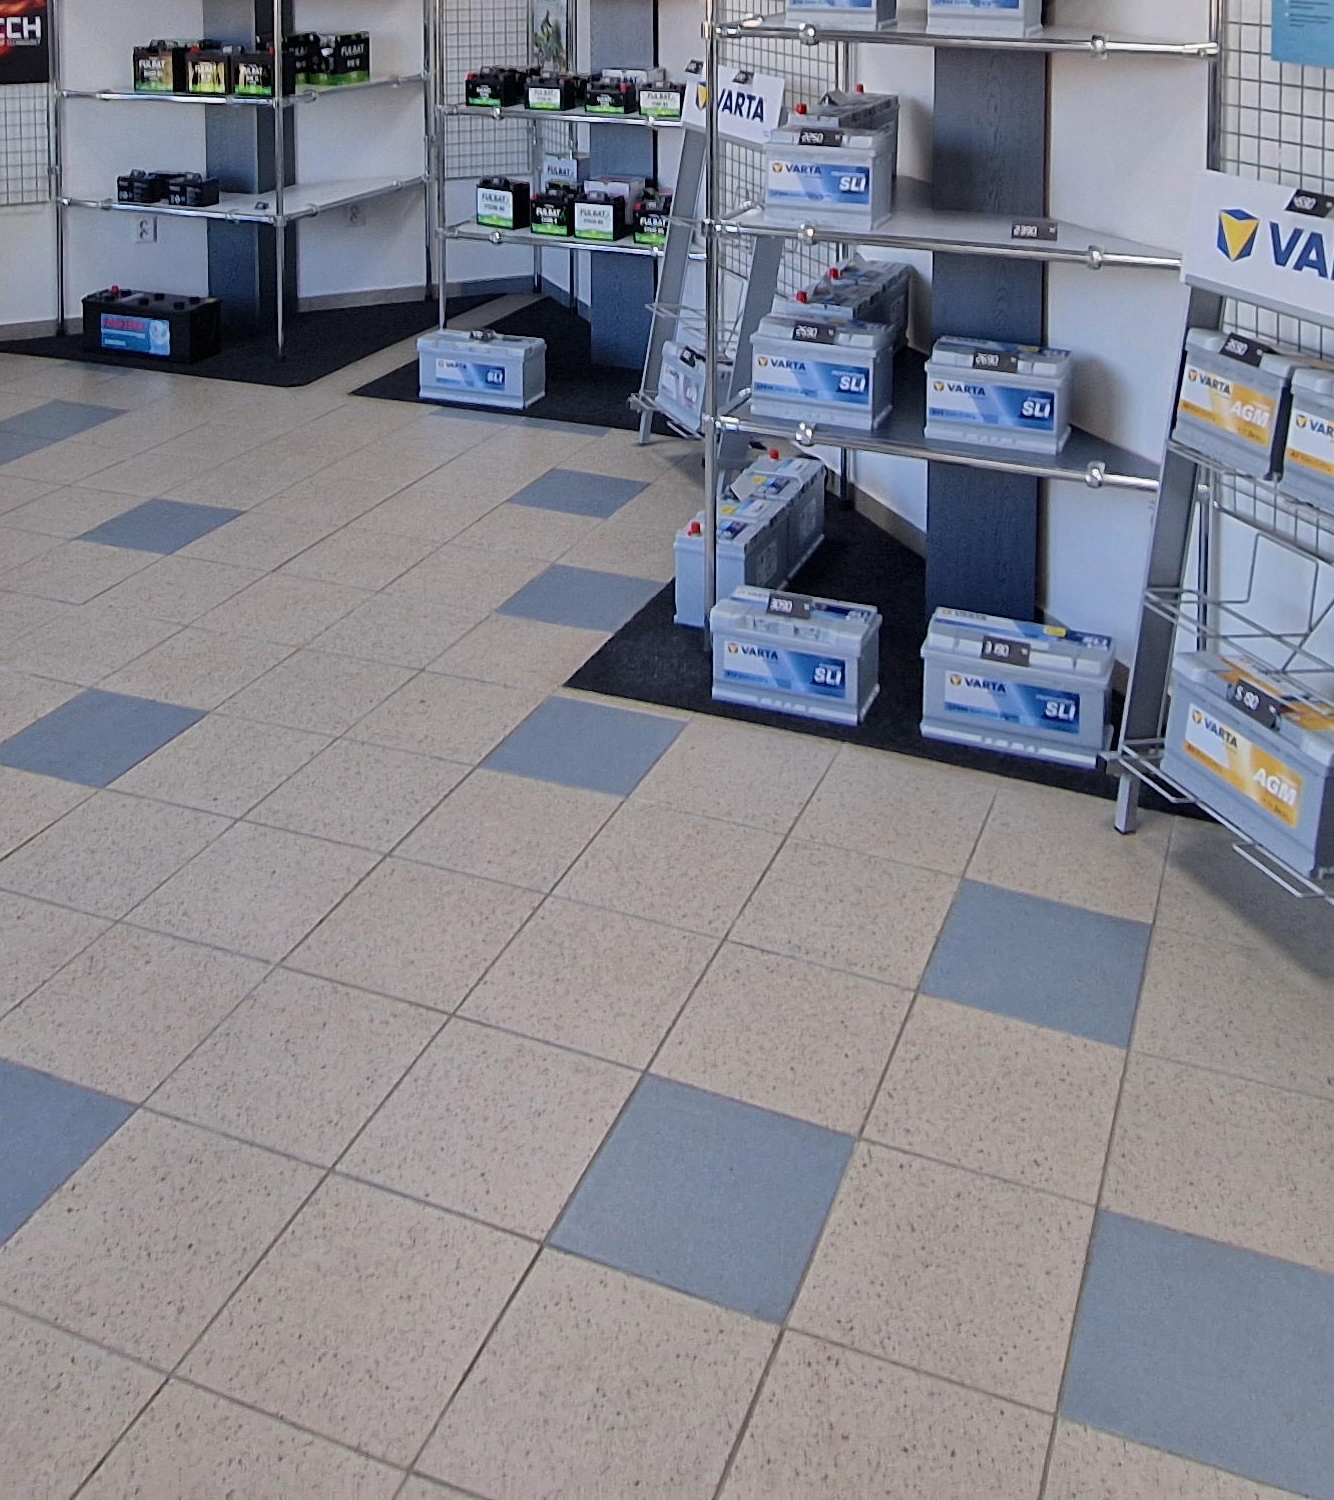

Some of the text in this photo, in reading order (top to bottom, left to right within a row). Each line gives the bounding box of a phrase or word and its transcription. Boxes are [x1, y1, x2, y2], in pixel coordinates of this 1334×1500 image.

[785, 164, 821, 176] VARTA
[839, 176, 866, 193] SLI
[481, 192, 506, 204] FULBAT
[579, 209, 605, 218] FULBAT
[771, 358, 806, 372] VARTA
[839, 375, 867, 394] SLI
[946, 382, 986, 397] VARTA
[1198, 373, 1231, 396] VARTA
[1021, 400, 1051, 419] SLI
[1230, 400, 1270, 428] AGM
[741, 644, 779, 661] VARTA
[813, 667, 842, 687] SLI
[964, 677, 1007, 694] VARTA
[1044, 701, 1077, 722] SLI
[1203, 715, 1238, 749] VARTA
[1252, 767, 1299, 806] AGM
